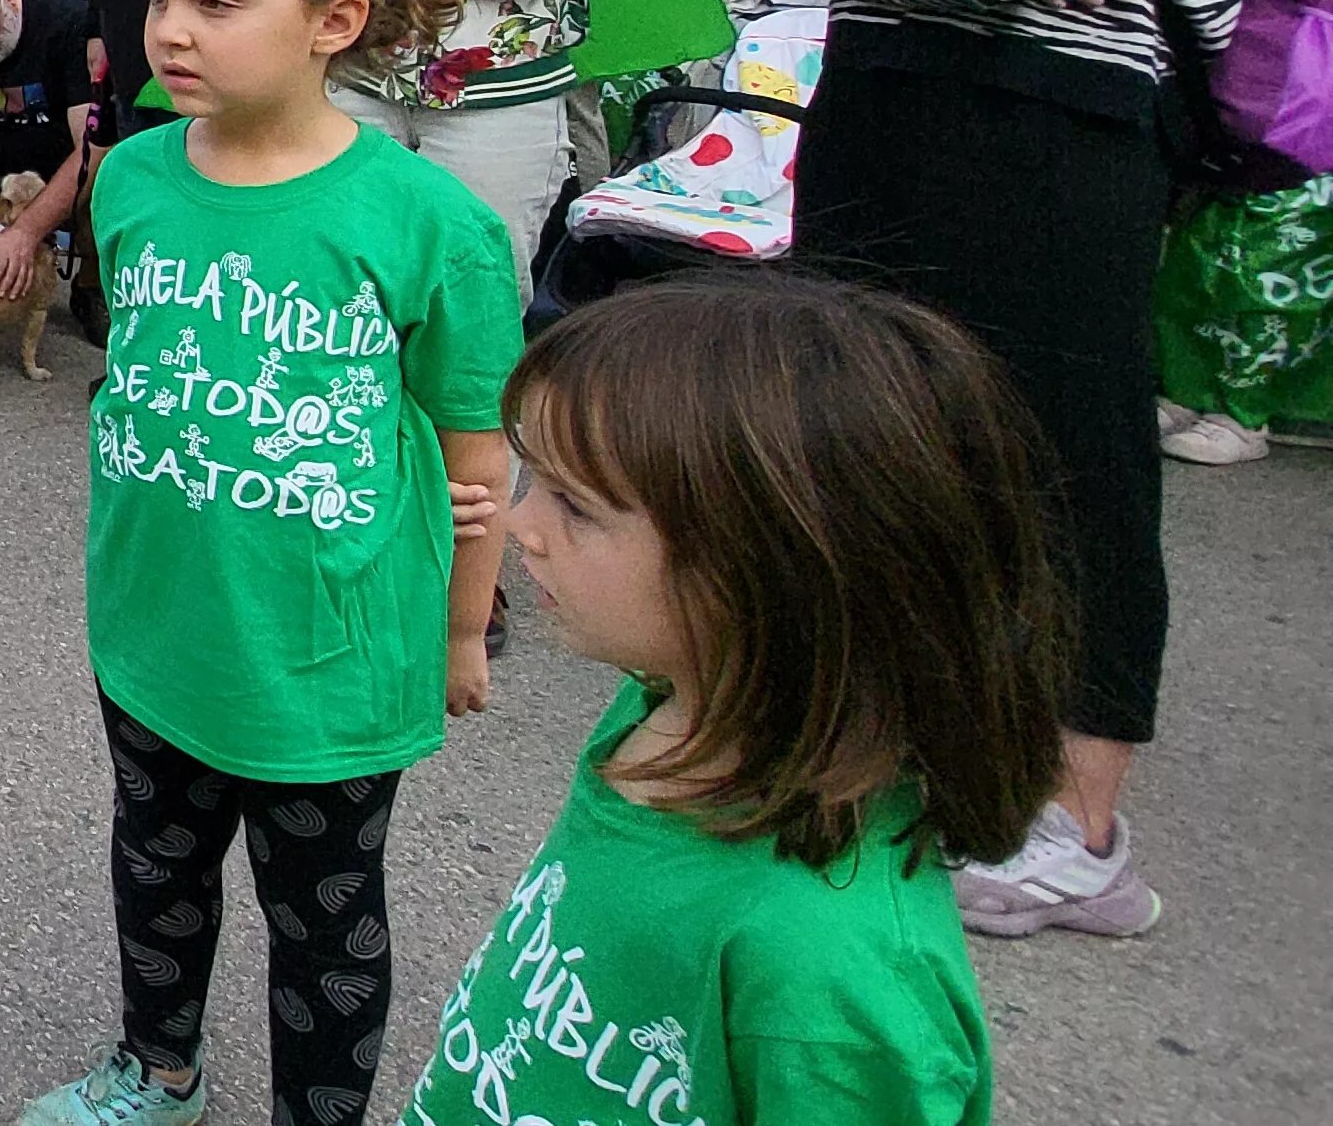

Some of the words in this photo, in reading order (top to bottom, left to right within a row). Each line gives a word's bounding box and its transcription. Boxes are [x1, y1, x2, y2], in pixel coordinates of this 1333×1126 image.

[112, 258, 225, 322] SCUELA
[173, 370, 364, 446] TOD@S
[198, 459, 377, 531] TOD@S
